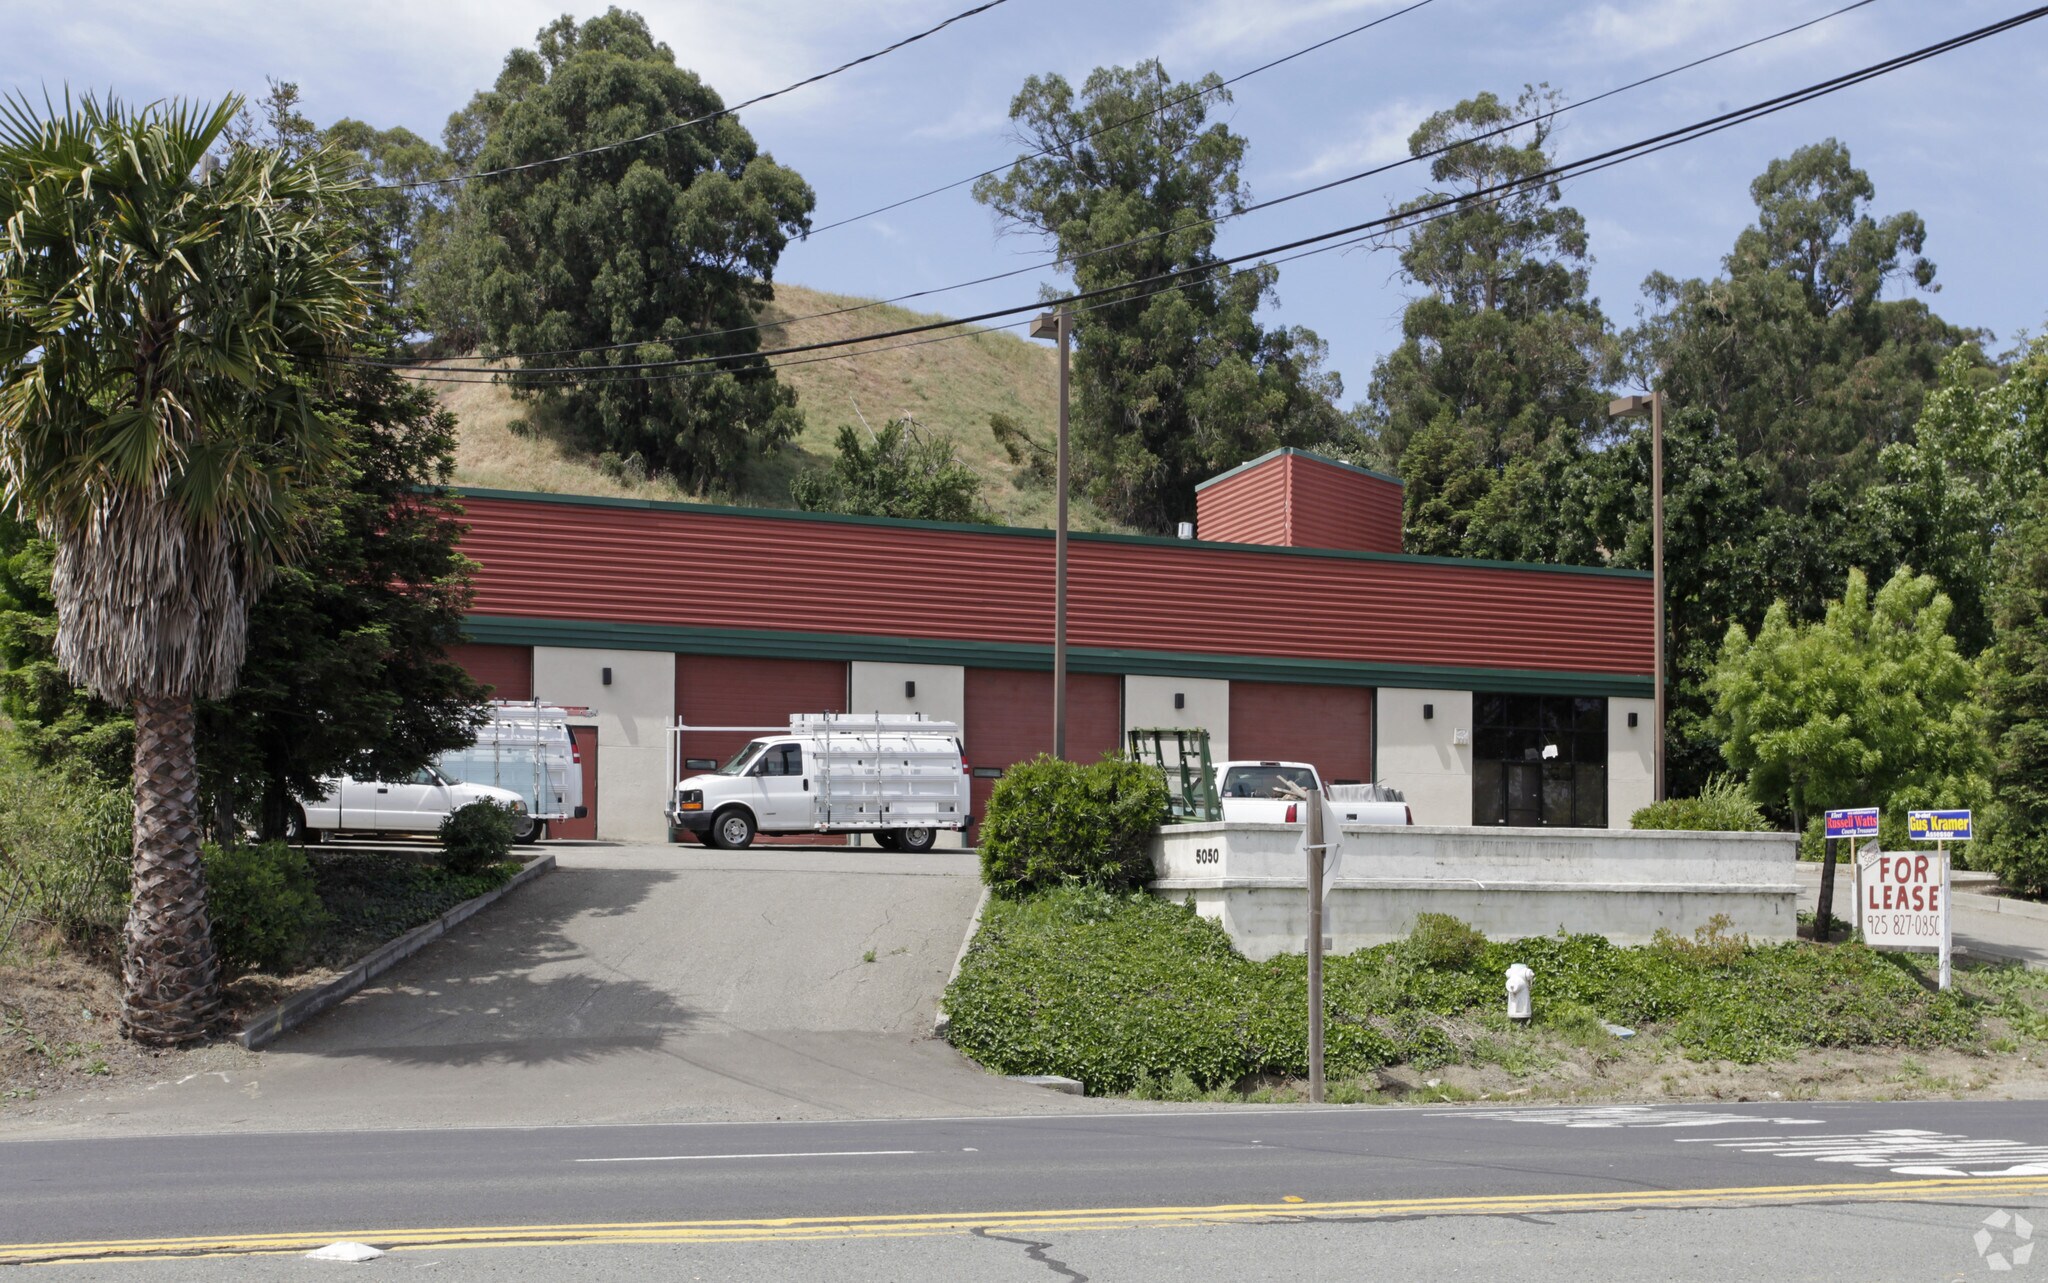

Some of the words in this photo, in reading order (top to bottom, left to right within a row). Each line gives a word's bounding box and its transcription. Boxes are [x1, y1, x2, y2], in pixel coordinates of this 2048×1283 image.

[1827, 815, 1853, 828] Russell
[1854, 815, 1877, 827] Watts
[1910, 816, 1928, 831] Gus
[1930, 816, 1969, 831] Kramer
[1196, 848, 1219, 864] 5050
[1880, 855, 1929, 884] FOR
[1869, 885, 1939, 911] LEASE
[1868, 915, 1888, 935] 925
